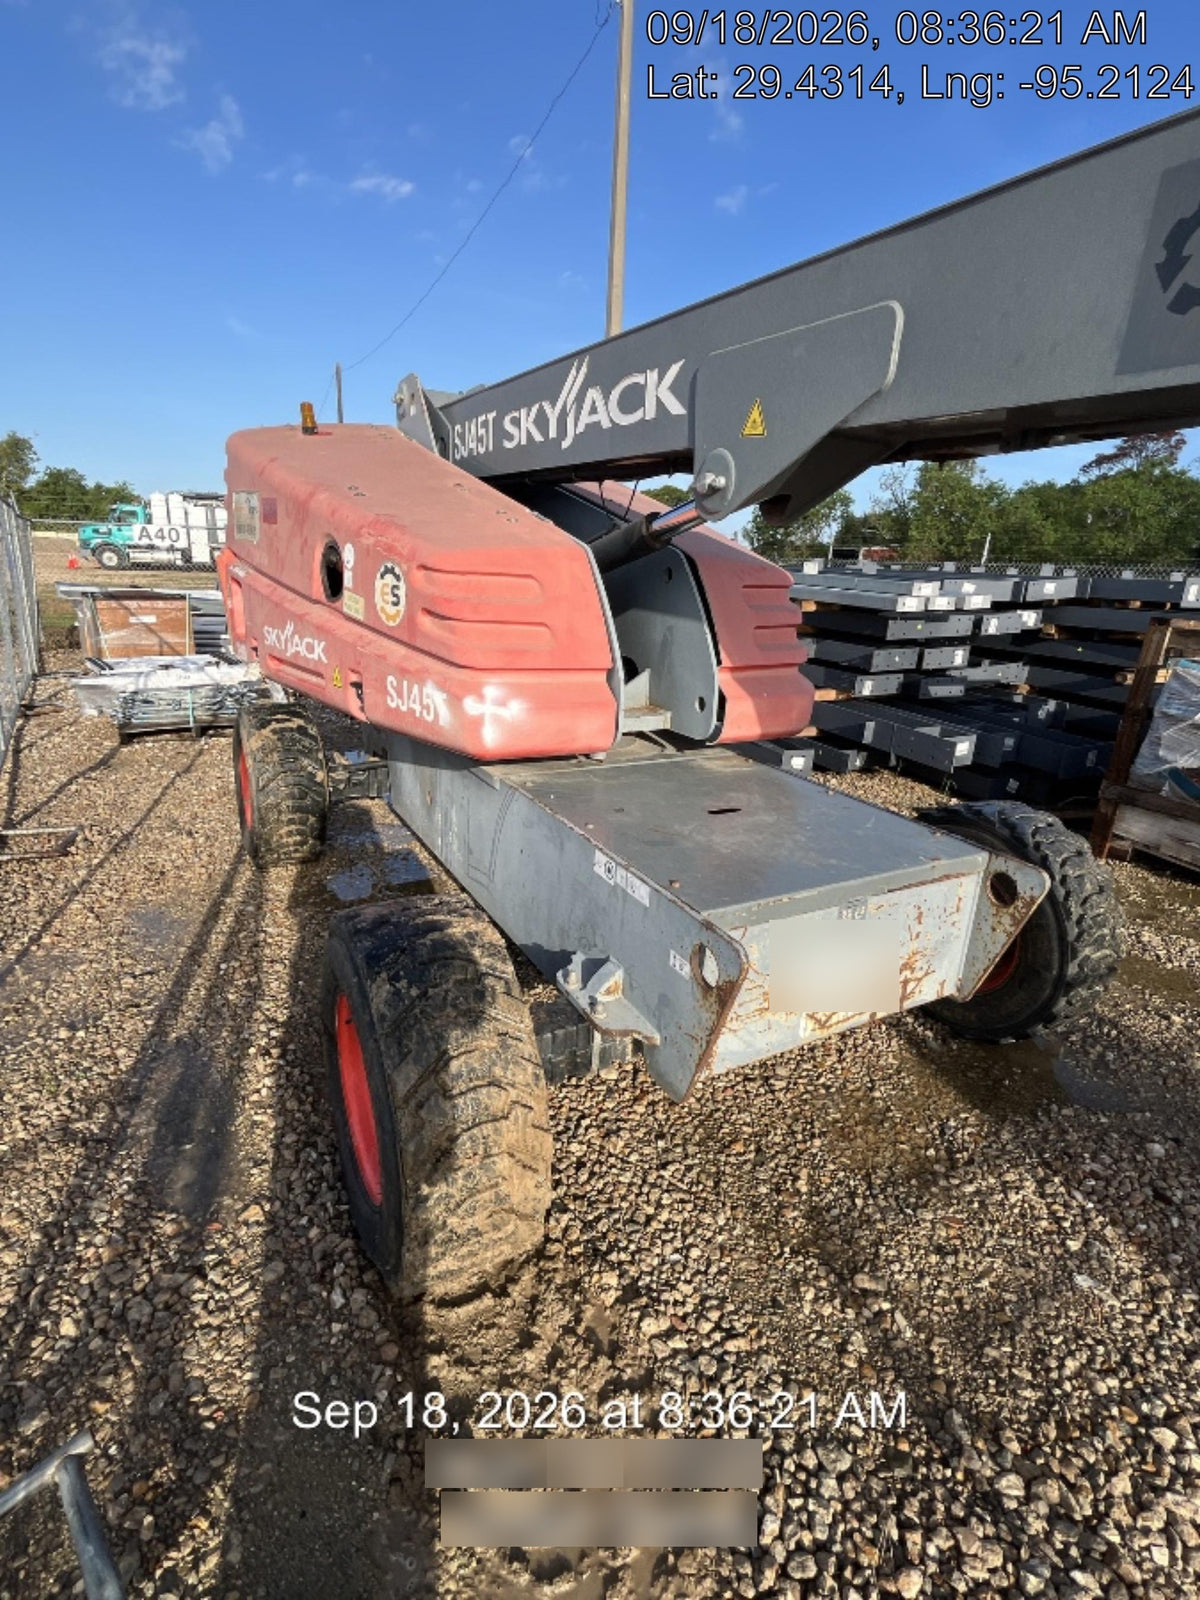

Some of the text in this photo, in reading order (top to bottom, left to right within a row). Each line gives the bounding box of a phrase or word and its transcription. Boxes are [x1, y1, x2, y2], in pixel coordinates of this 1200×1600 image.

[454, 355, 688, 461] SJ45T SKYJACK
[137, 525, 181, 543] A40
[262, 619, 328, 664] SKYJACK
